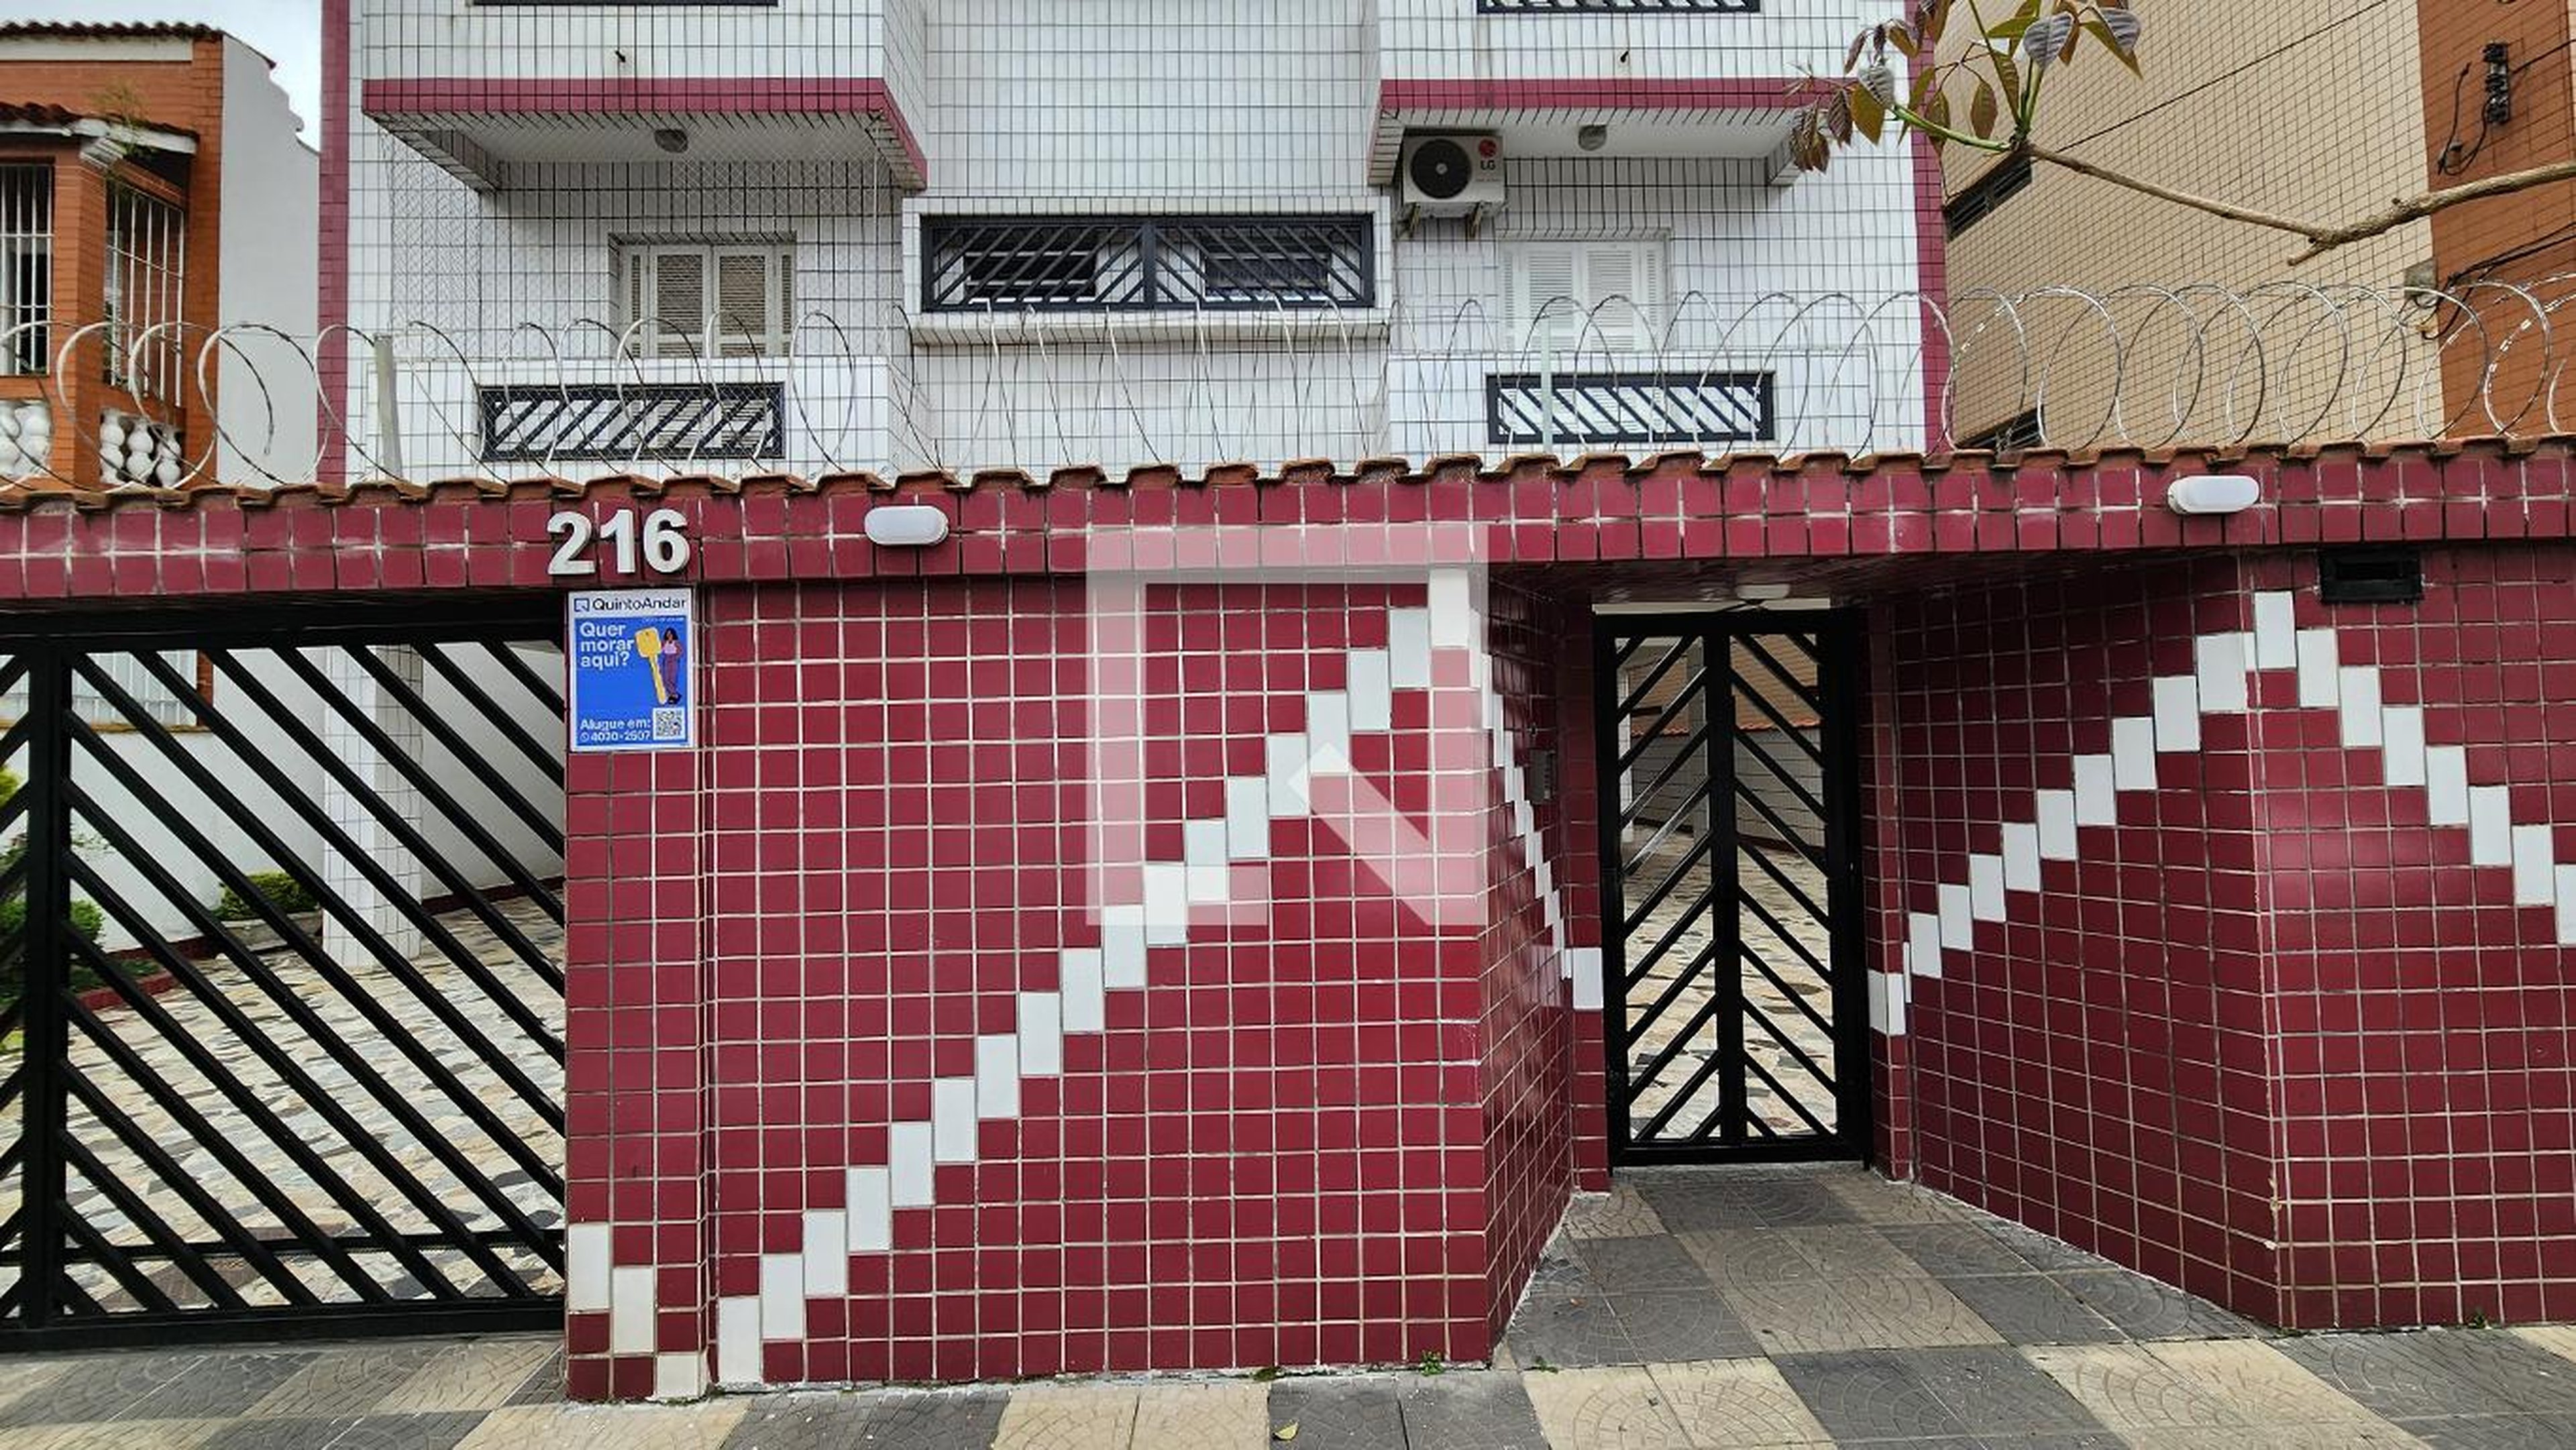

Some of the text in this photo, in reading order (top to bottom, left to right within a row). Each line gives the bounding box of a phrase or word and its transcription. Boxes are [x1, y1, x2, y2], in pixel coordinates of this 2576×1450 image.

[1481, 160, 1496, 170] LG
[547, 508, 690, 575] 216
[592, 597, 686, 611] QuintoAndar
[580, 622, 626, 638] Quer
[581, 639, 635, 652] morar
[581, 651, 630, 670] aqui?
[580, 718, 651, 731] Alugue em:
